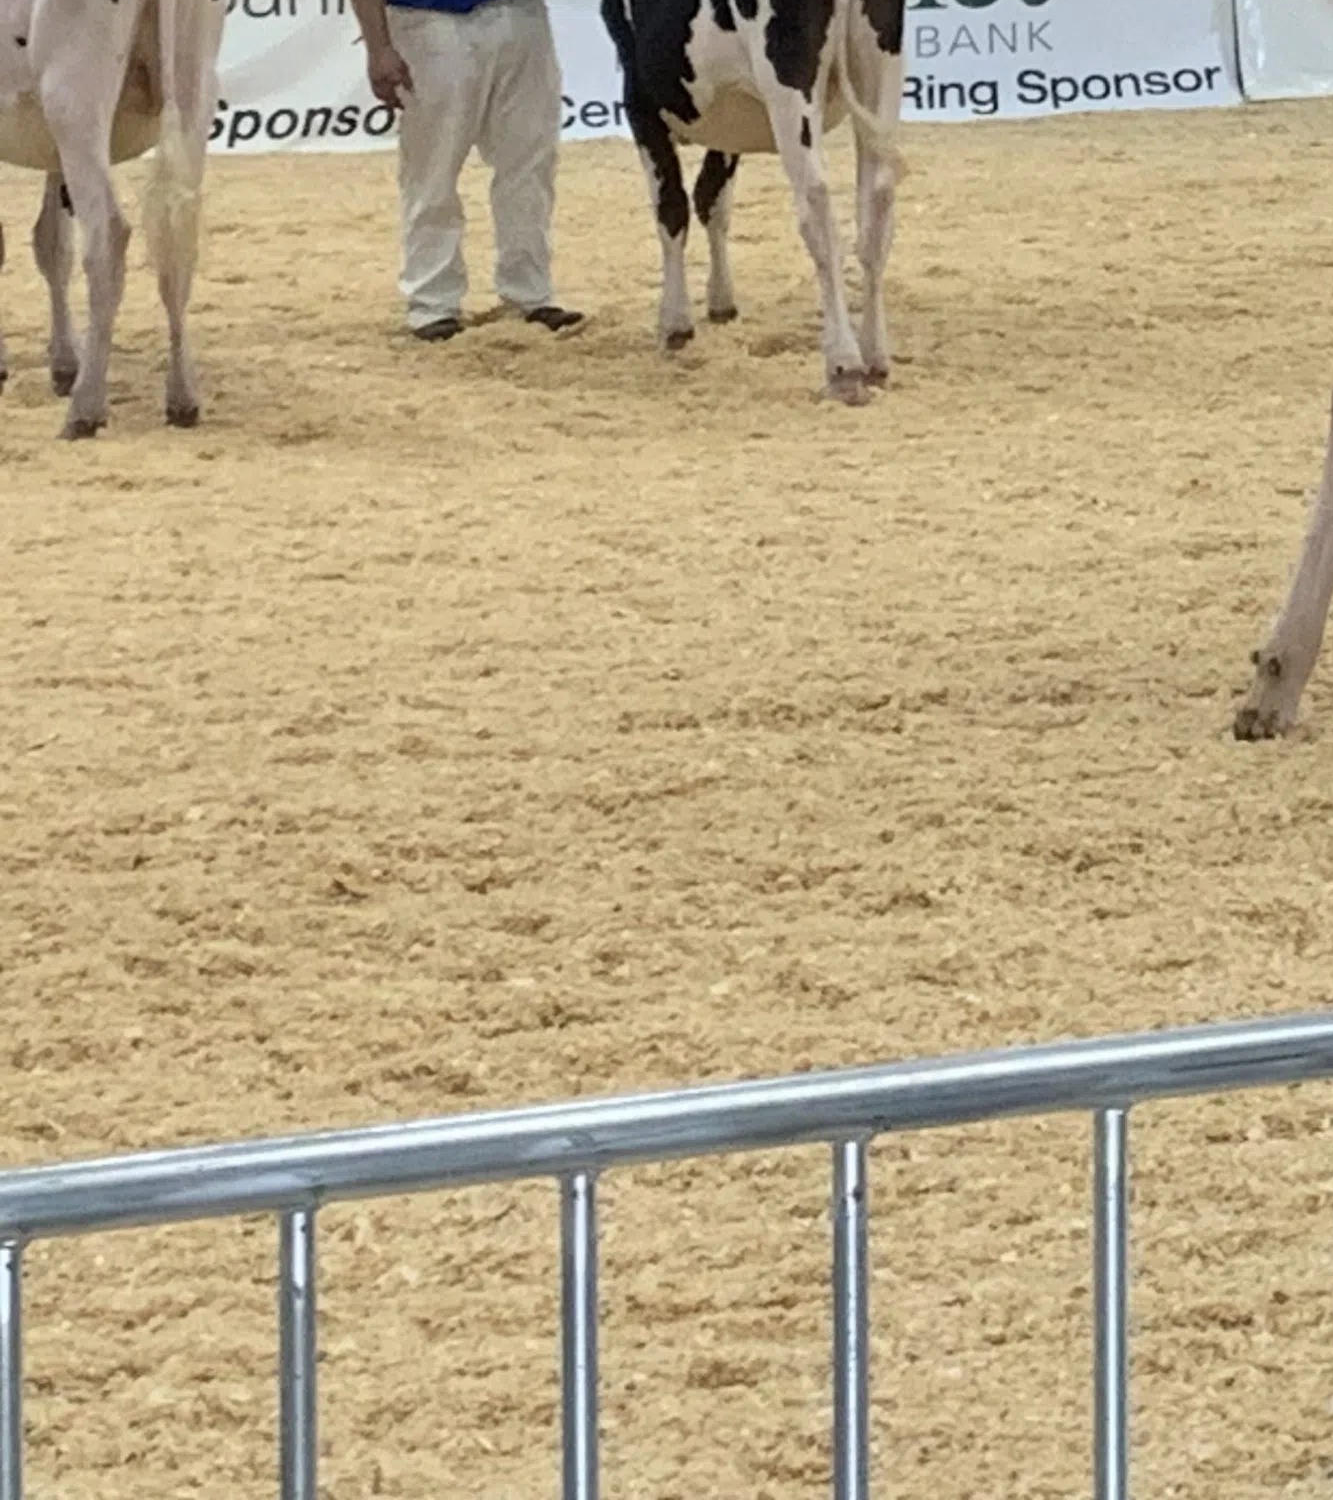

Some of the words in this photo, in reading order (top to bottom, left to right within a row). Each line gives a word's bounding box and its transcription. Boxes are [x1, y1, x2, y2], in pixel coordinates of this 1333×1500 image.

[915, 20, 1054, 59] BANK
[904, 75, 999, 115] Ring
[1016, 65, 1223, 110] Sponsor
